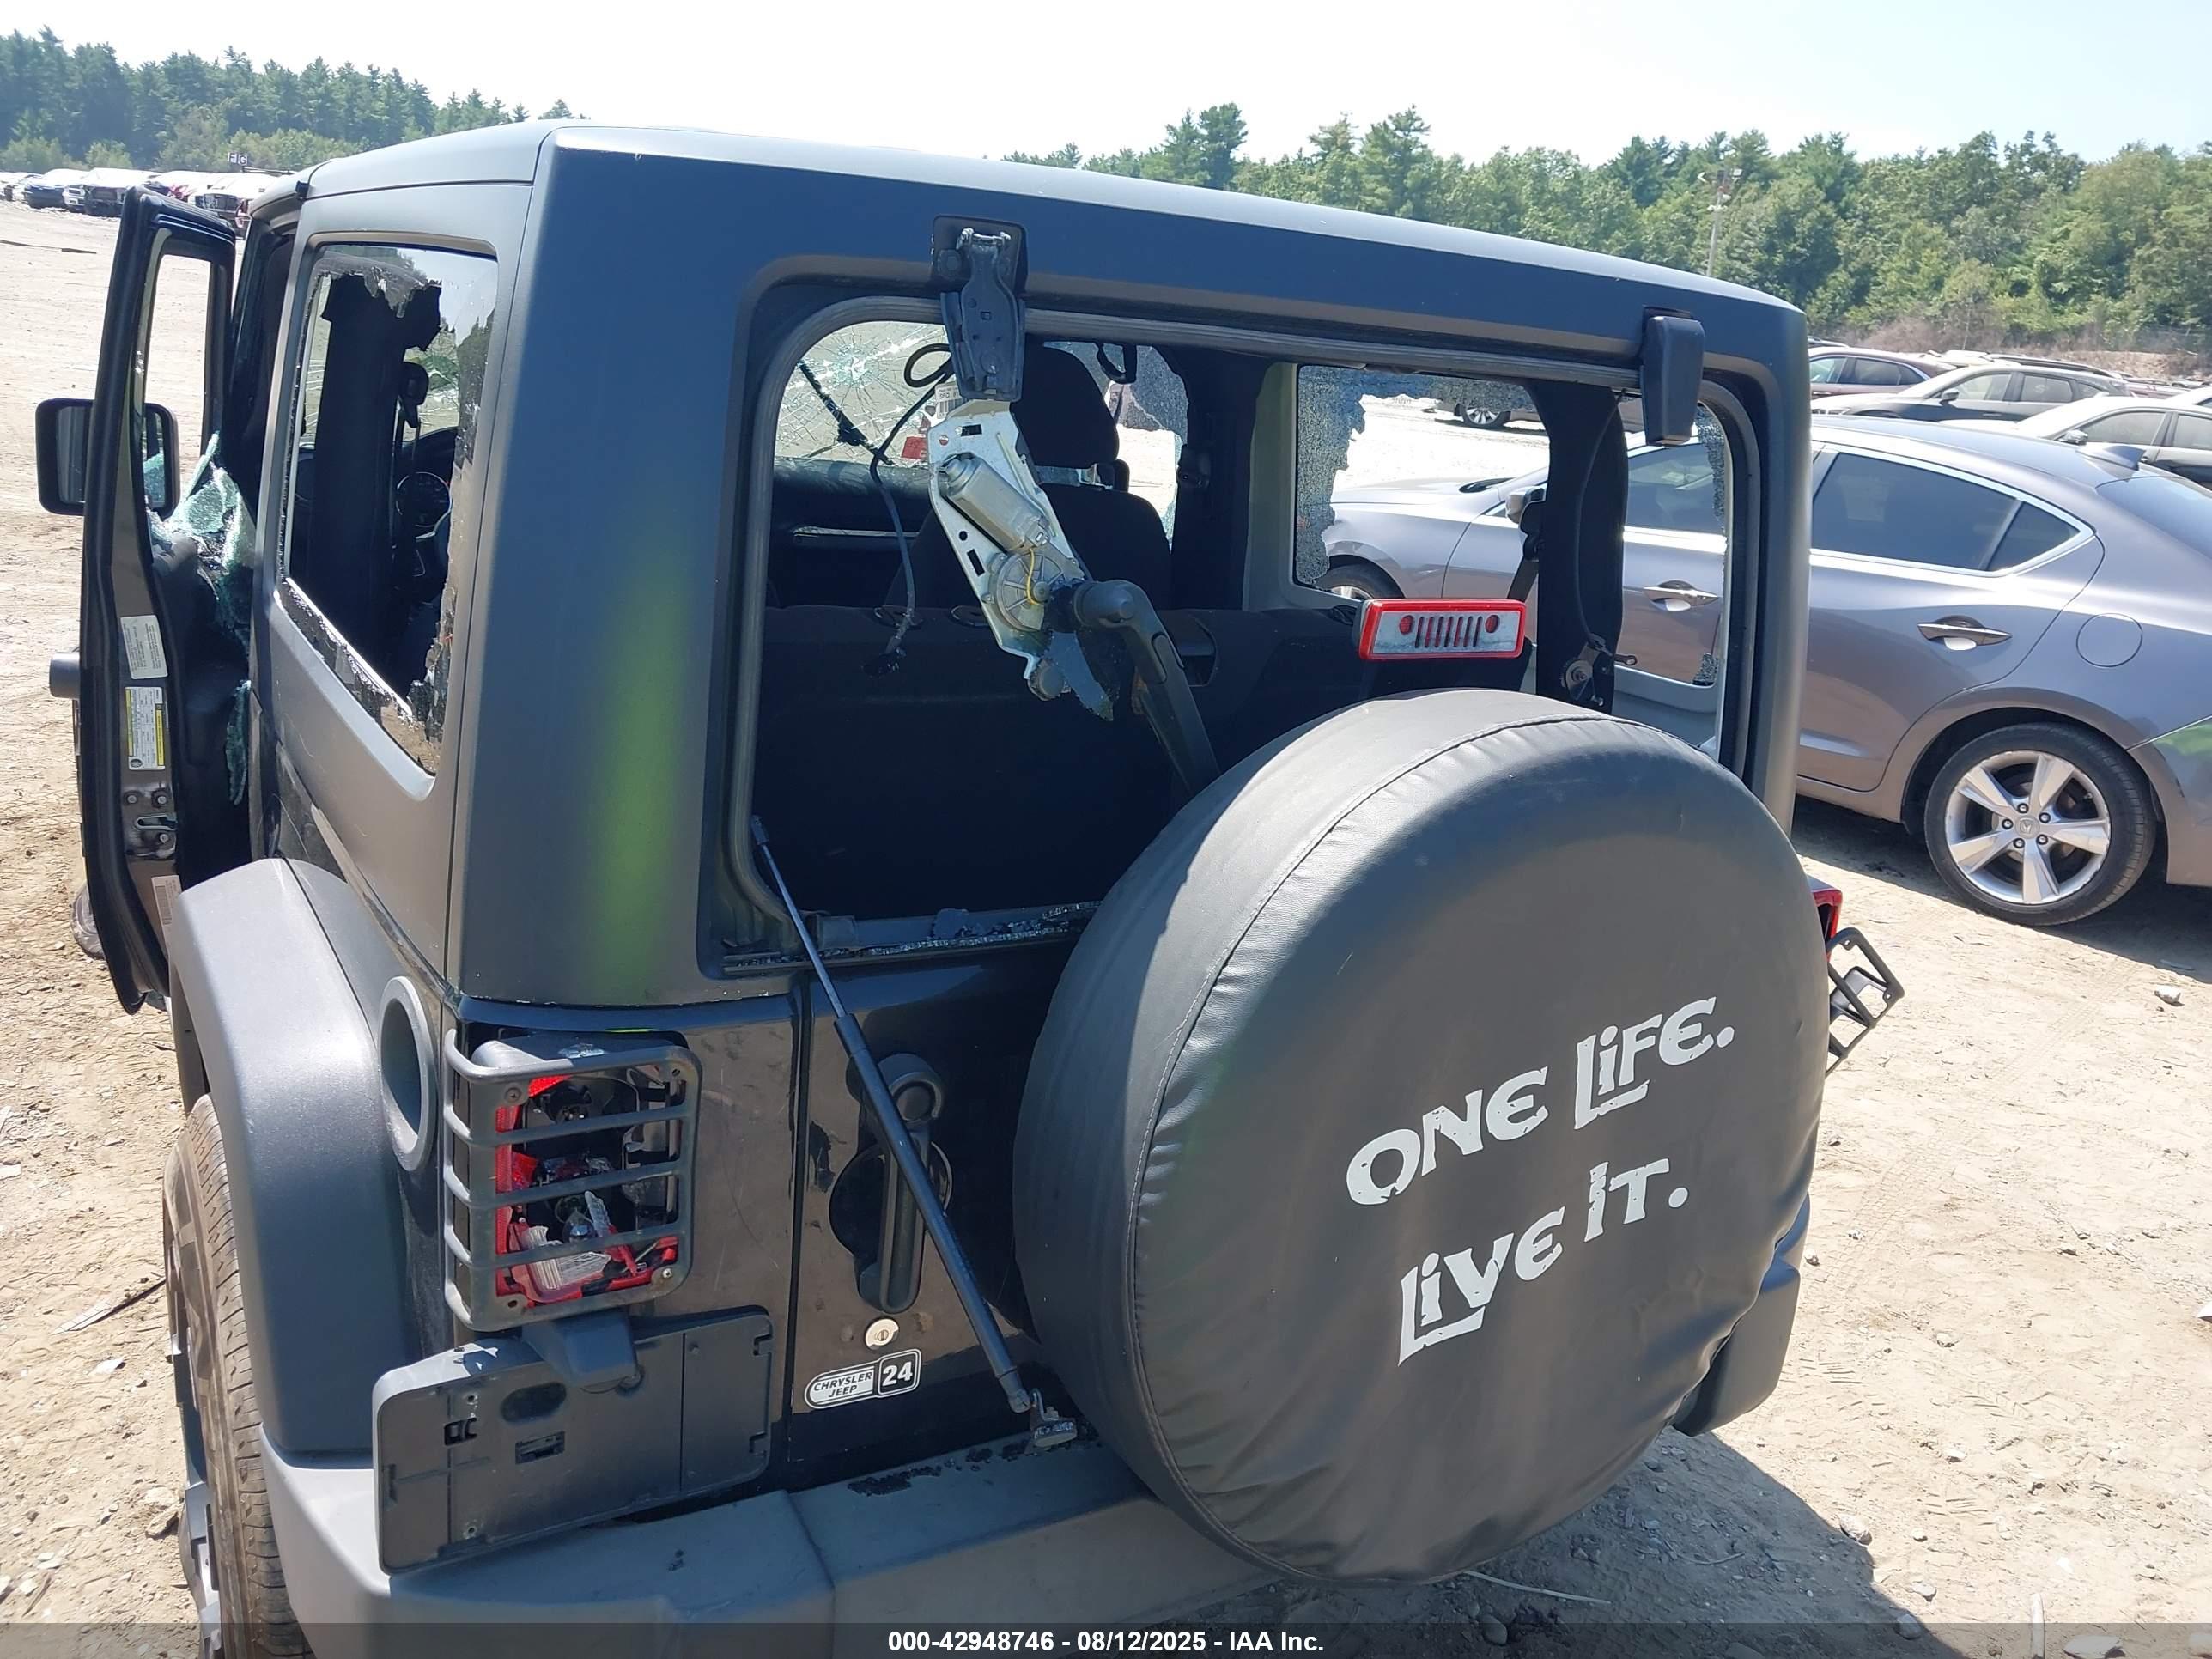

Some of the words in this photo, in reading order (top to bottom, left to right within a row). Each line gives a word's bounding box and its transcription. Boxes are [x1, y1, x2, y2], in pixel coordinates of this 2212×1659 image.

[1346, 1066, 1549, 1206] ONE
[814, 1372, 872, 1391] CHRYSLER
[883, 1362, 913, 1386] 24
[829, 1385, 857, 1397] JEEP
